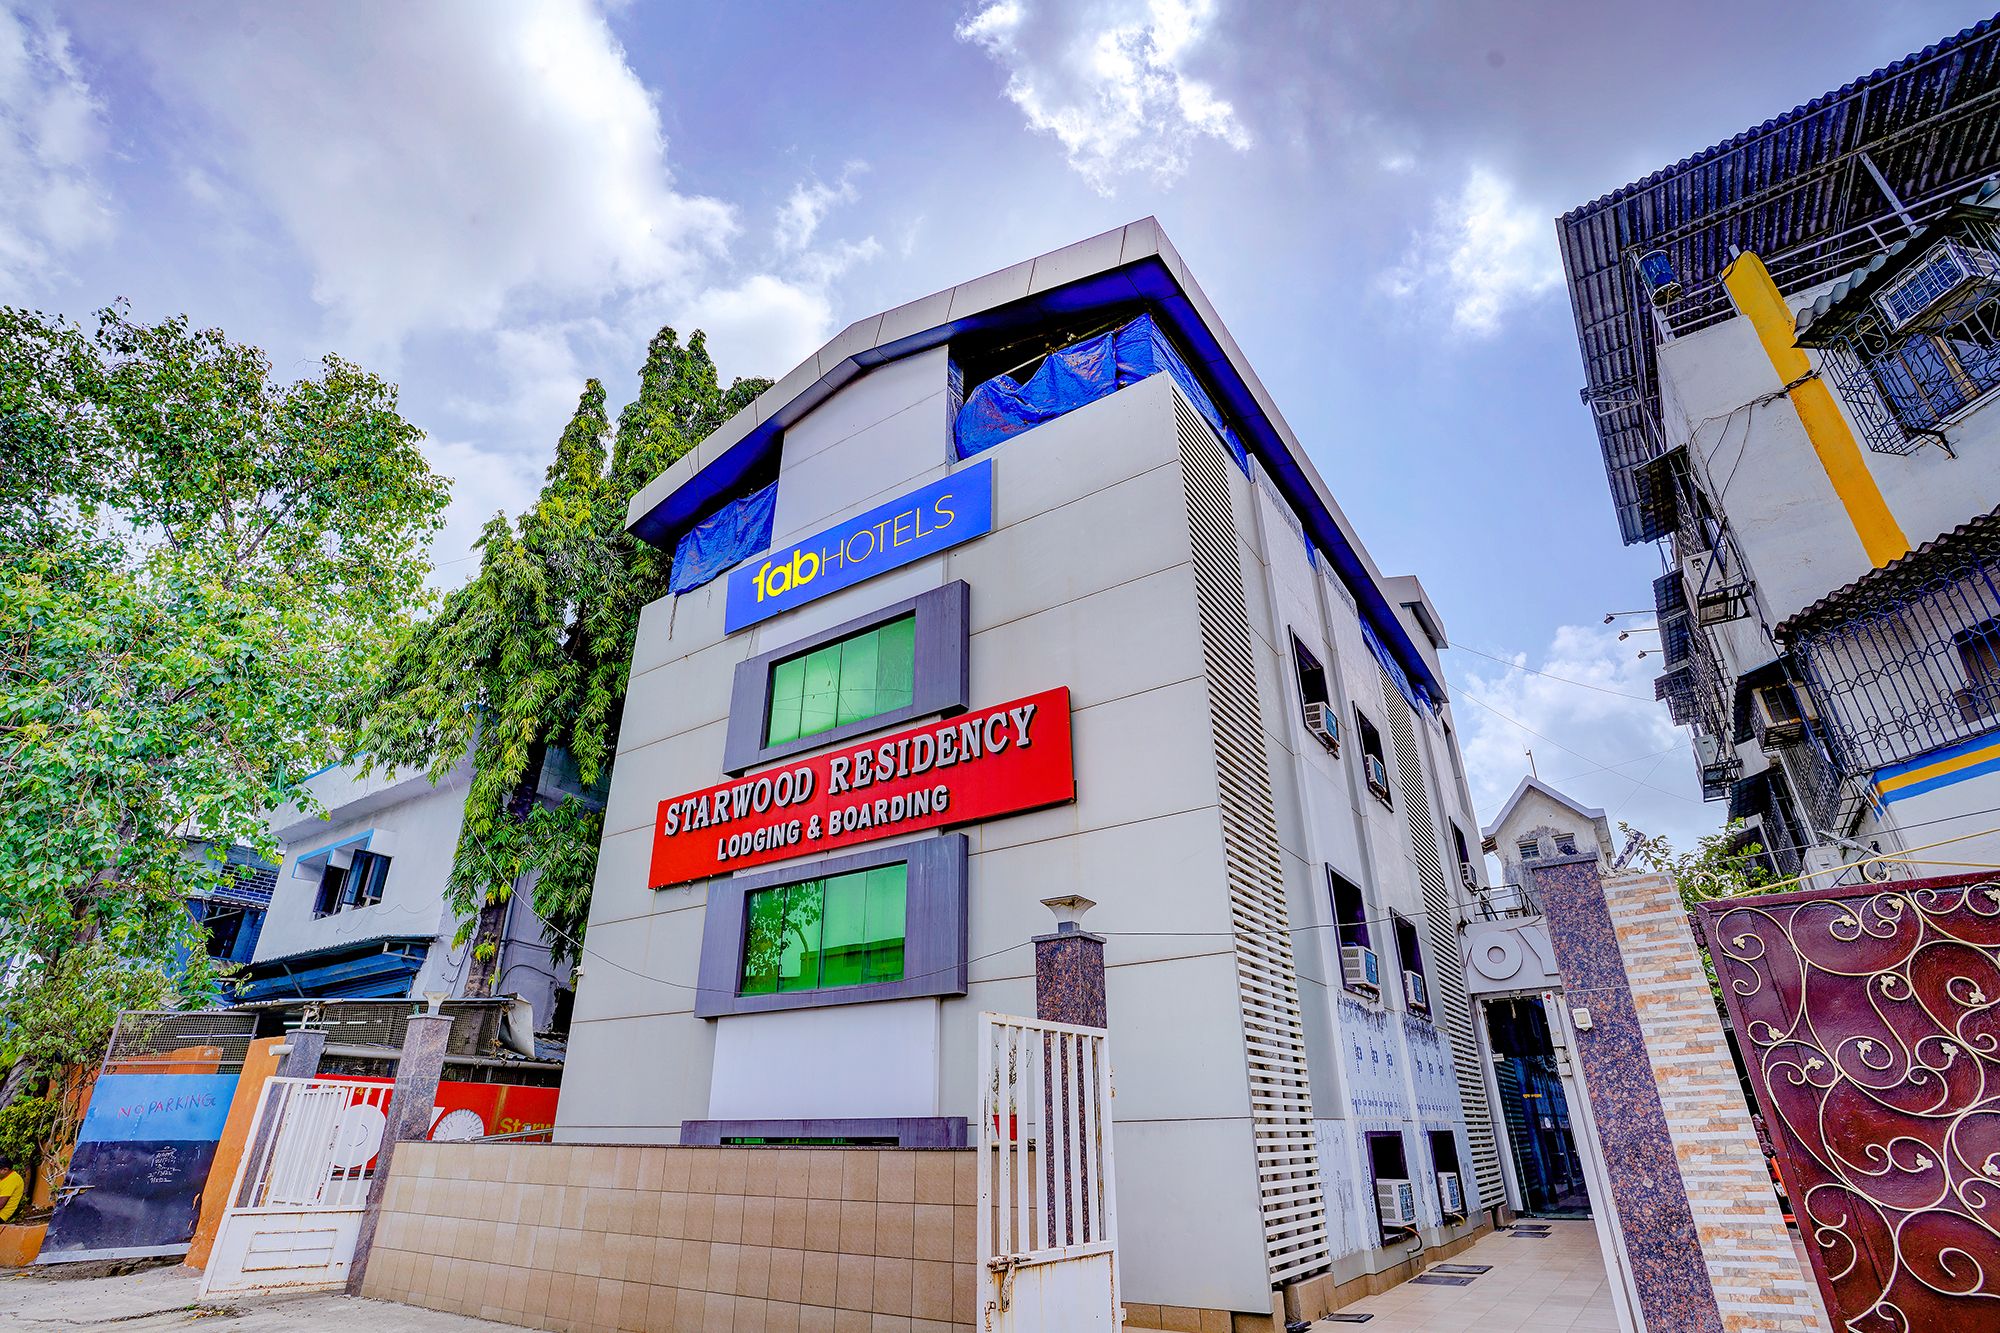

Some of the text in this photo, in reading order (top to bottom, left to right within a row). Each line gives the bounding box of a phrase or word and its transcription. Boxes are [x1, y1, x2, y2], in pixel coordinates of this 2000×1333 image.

[752, 494, 955, 603] fabHOTELS
[664, 703, 1036, 836] STARWOOD RESIDENCY
[717, 784, 949, 862] LODGING & BOARDING
[118, 1092, 216, 1118] NO PARKING
